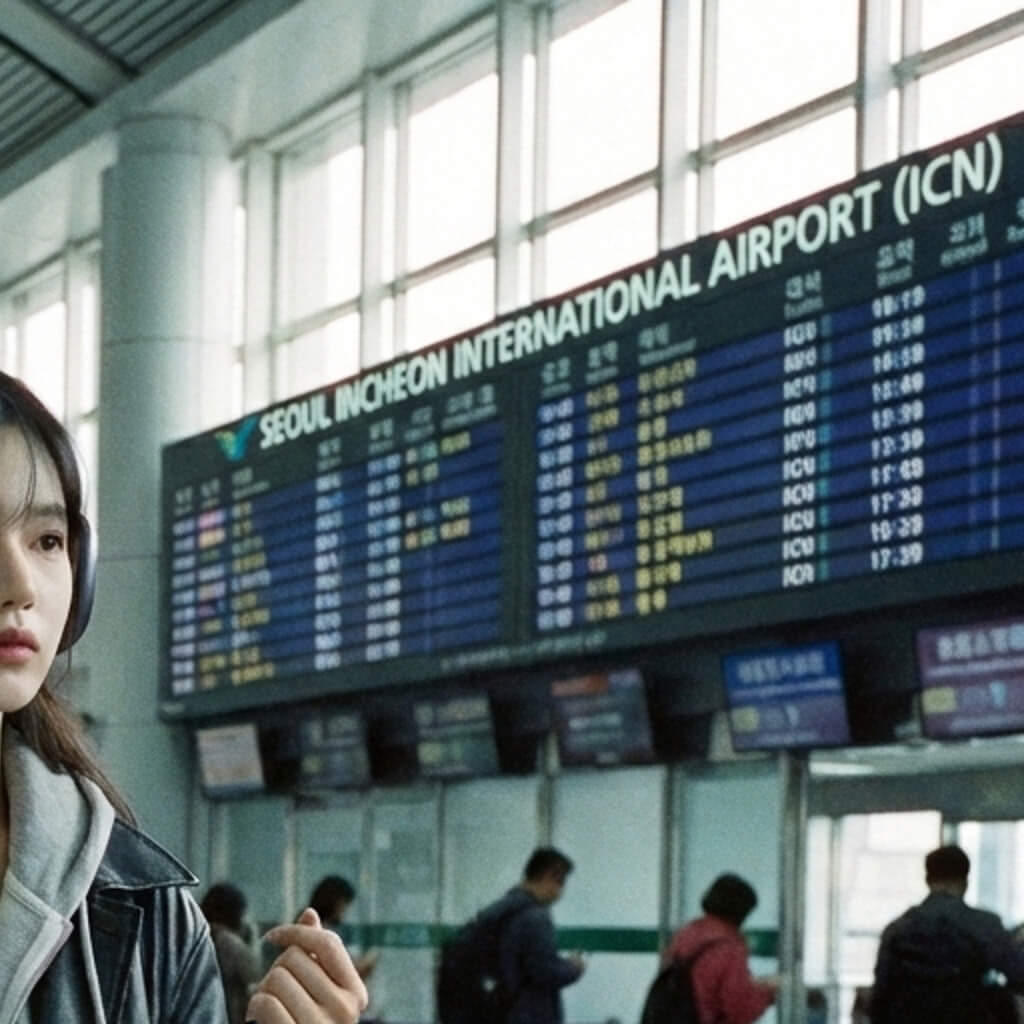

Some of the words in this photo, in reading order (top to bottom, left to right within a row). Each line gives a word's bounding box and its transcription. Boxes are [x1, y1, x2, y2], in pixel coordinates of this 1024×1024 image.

[260, 395, 332, 449] SEOUL
[335, 350, 448, 422] INCHEON
[452, 253, 701, 379] INTERNATIONAL
[708, 181, 881, 288] AIRPORT
[893, 132, 1003, 225] (ICN)
